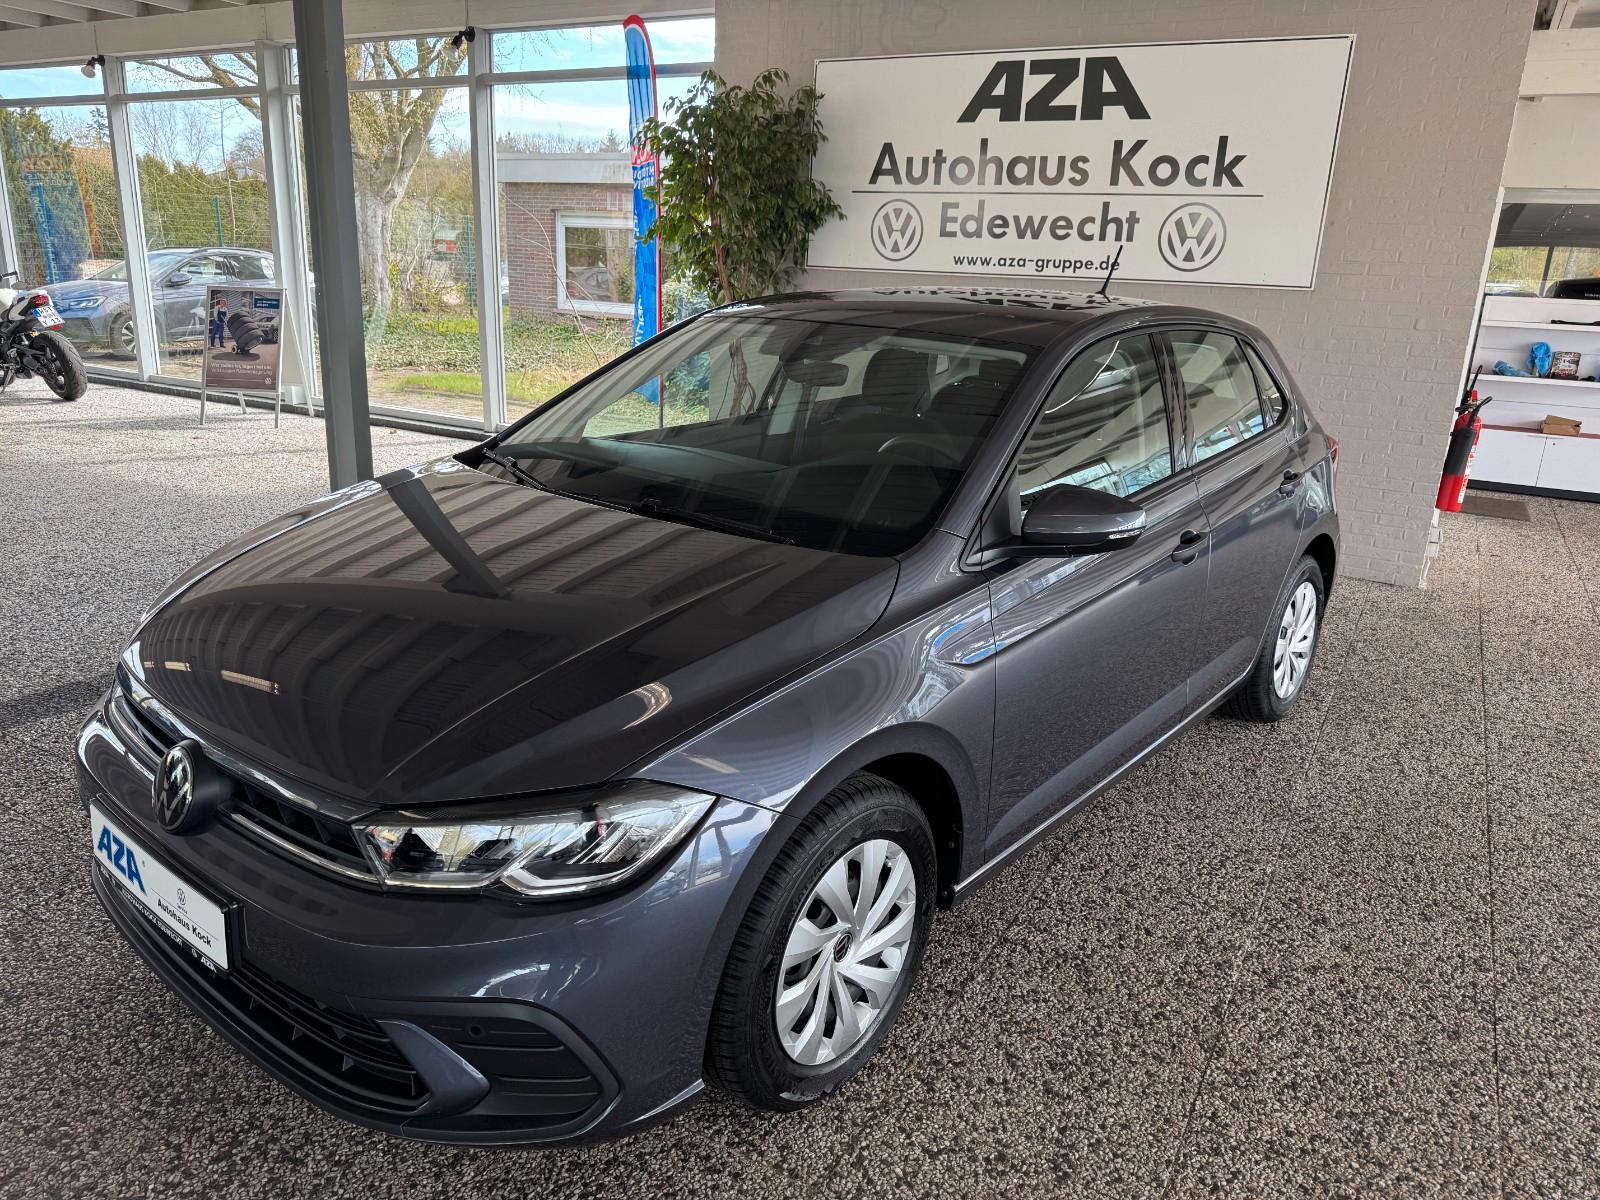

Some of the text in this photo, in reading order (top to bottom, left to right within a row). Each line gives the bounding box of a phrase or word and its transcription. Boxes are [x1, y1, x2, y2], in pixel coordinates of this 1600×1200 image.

[957, 56, 1151, 122] AZA
[868, 136, 1248, 187] Autohaus Kock
[939, 200, 1141, 243] Edewecht
[953, 254, 1120, 274] www.aza-gruppe.de
[97, 825, 148, 897] AZA
[157, 898, 190, 931] Autohaus
[192, 925, 212, 948] Kock
